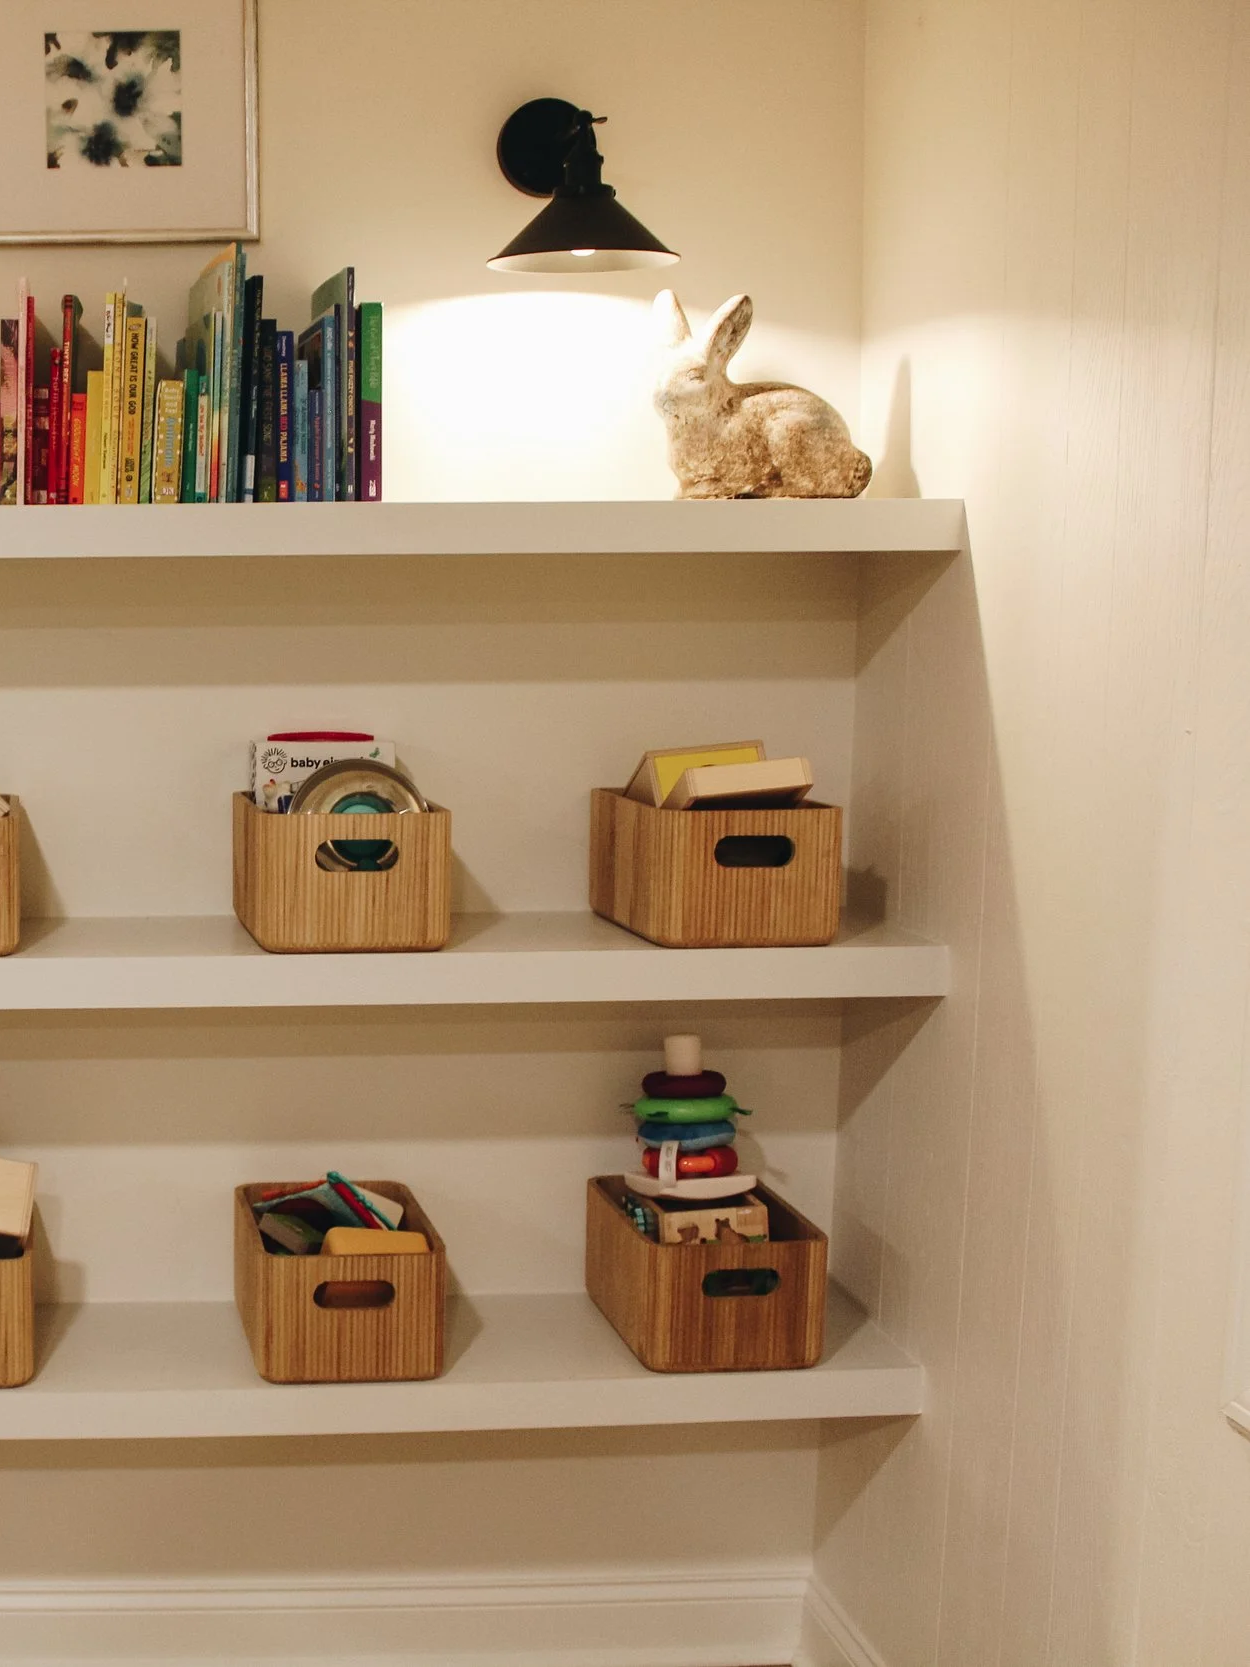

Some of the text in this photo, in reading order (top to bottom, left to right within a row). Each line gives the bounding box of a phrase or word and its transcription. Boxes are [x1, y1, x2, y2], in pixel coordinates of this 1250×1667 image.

[131, 333, 139, 349] HOW
[130, 352, 138, 373] GREAT
[129, 384, 137, 398] OUR
[128, 400, 136, 415] GOD
[280, 363, 288, 463] LLAMA LLAMA RED PAJAMA
[368, 420, 376, 434] Marty
[72, 418, 82, 461] GOODNIGHT
[164, 417, 177, 468] Animals
[71, 463, 80, 488] MOON
[161, 487, 175, 496] DK
[291, 757, 321, 769] baby
